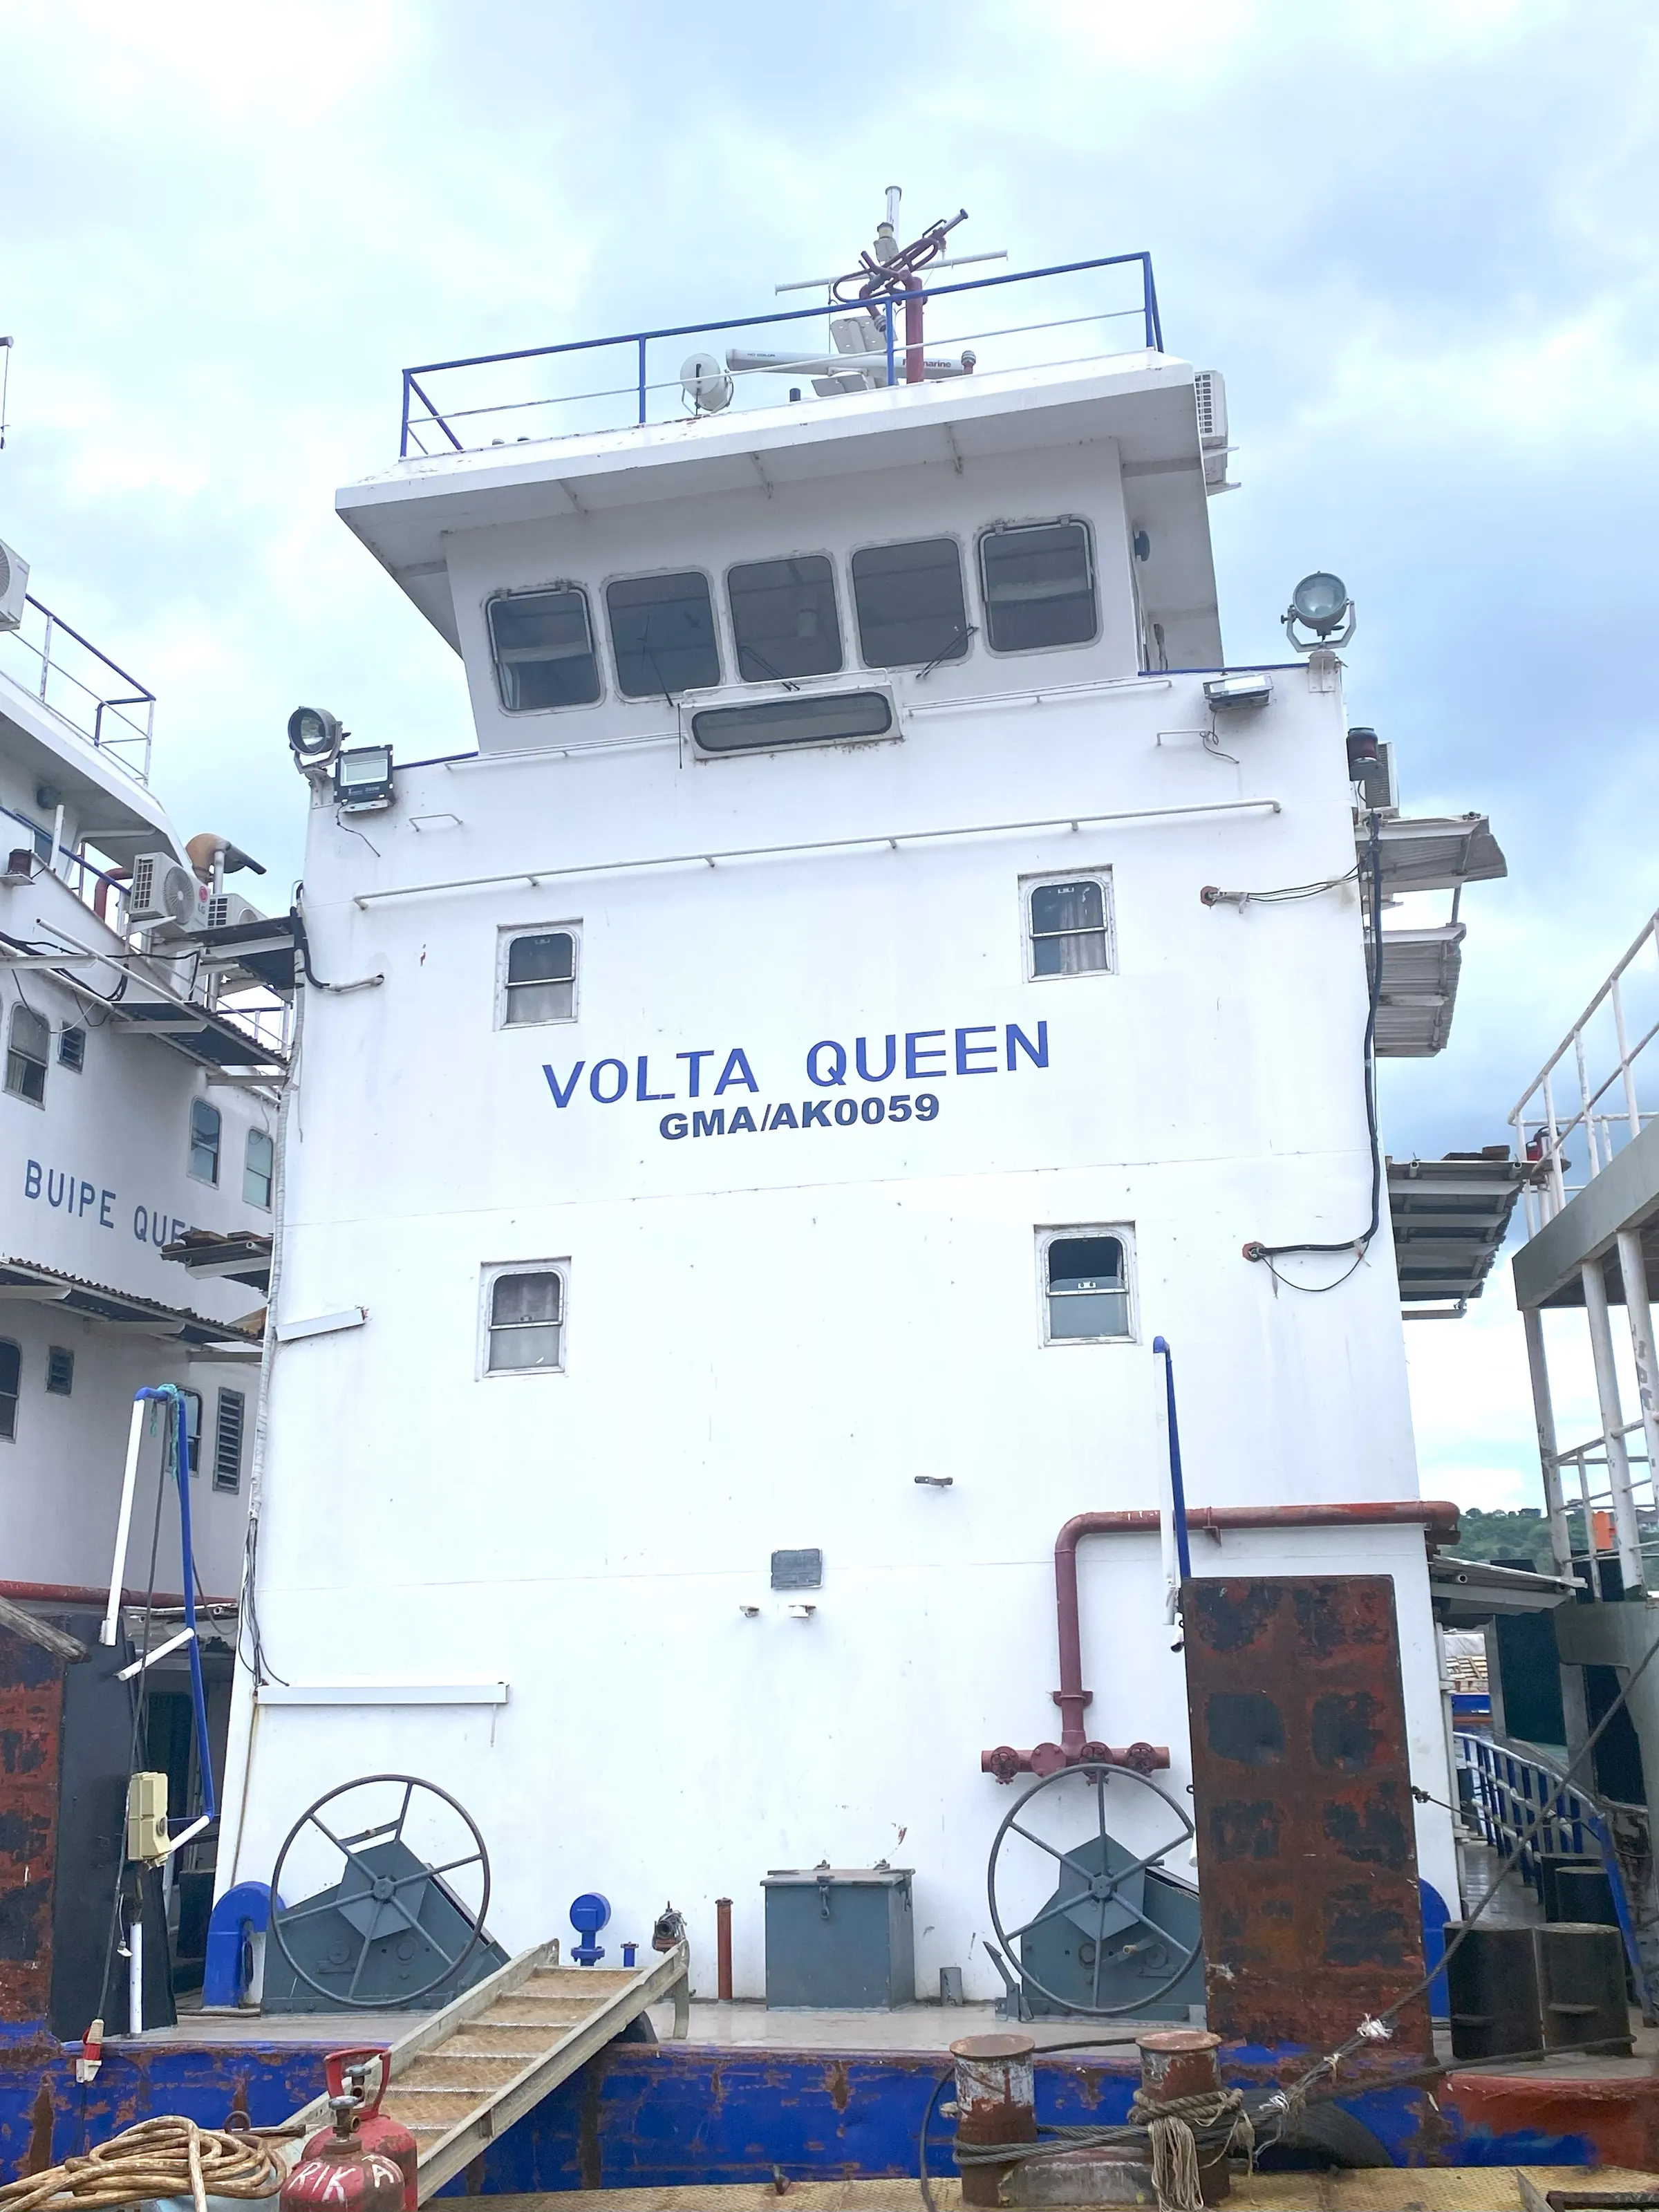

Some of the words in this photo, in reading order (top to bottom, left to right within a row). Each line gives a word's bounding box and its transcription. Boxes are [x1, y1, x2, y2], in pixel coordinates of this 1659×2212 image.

[198, 903, 206, 915] LG
[542, 1048, 760, 1109] VOLTA
[806, 1020, 1049, 1087] QUEEN
[659, 1093, 939, 1141] GMA/AK0059
[25, 1159, 116, 1229] BUIPE
[133, 1205, 202, 1247] QUE
